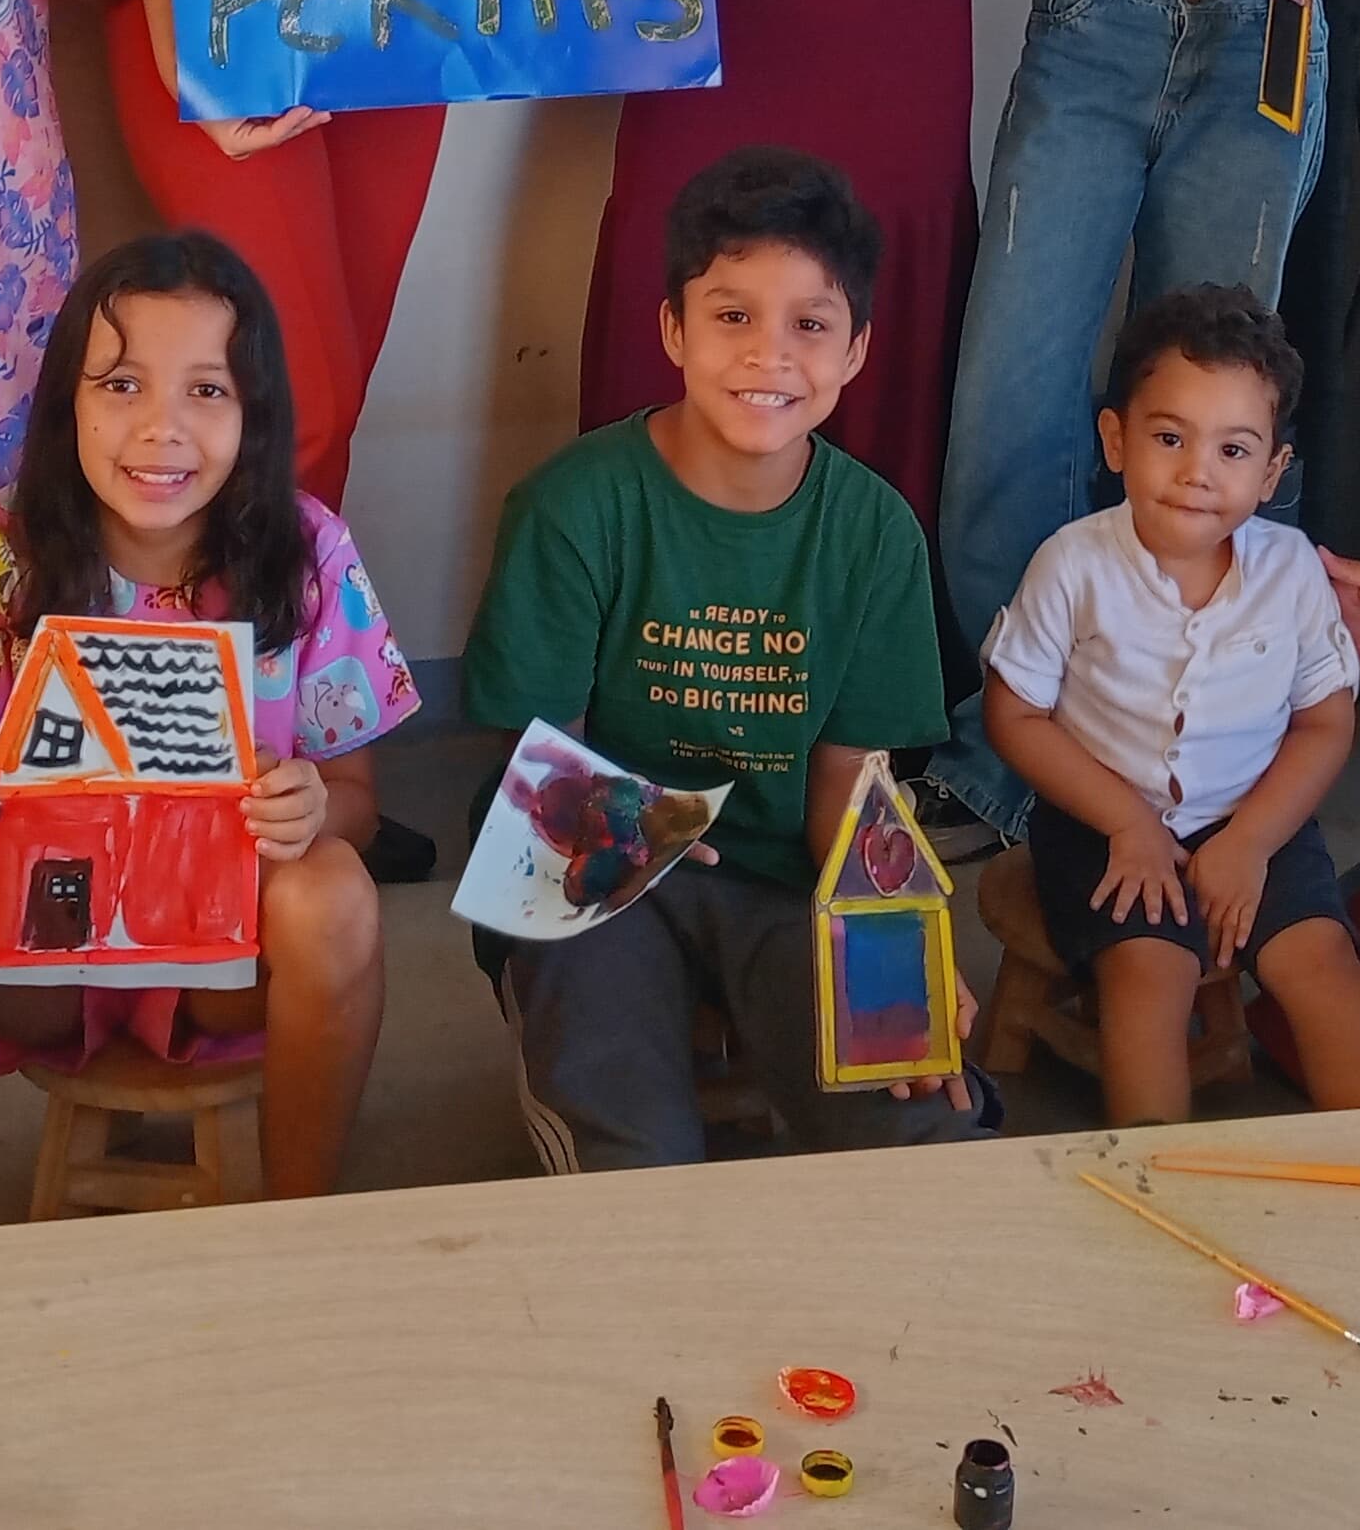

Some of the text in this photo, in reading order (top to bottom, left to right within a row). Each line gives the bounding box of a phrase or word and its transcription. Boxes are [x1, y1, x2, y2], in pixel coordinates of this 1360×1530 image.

[773, 614, 786, 623] TO
[642, 621, 810, 655] CHANGE NO
[672, 660, 694, 677] IN
[649, 686, 678, 705] DO
